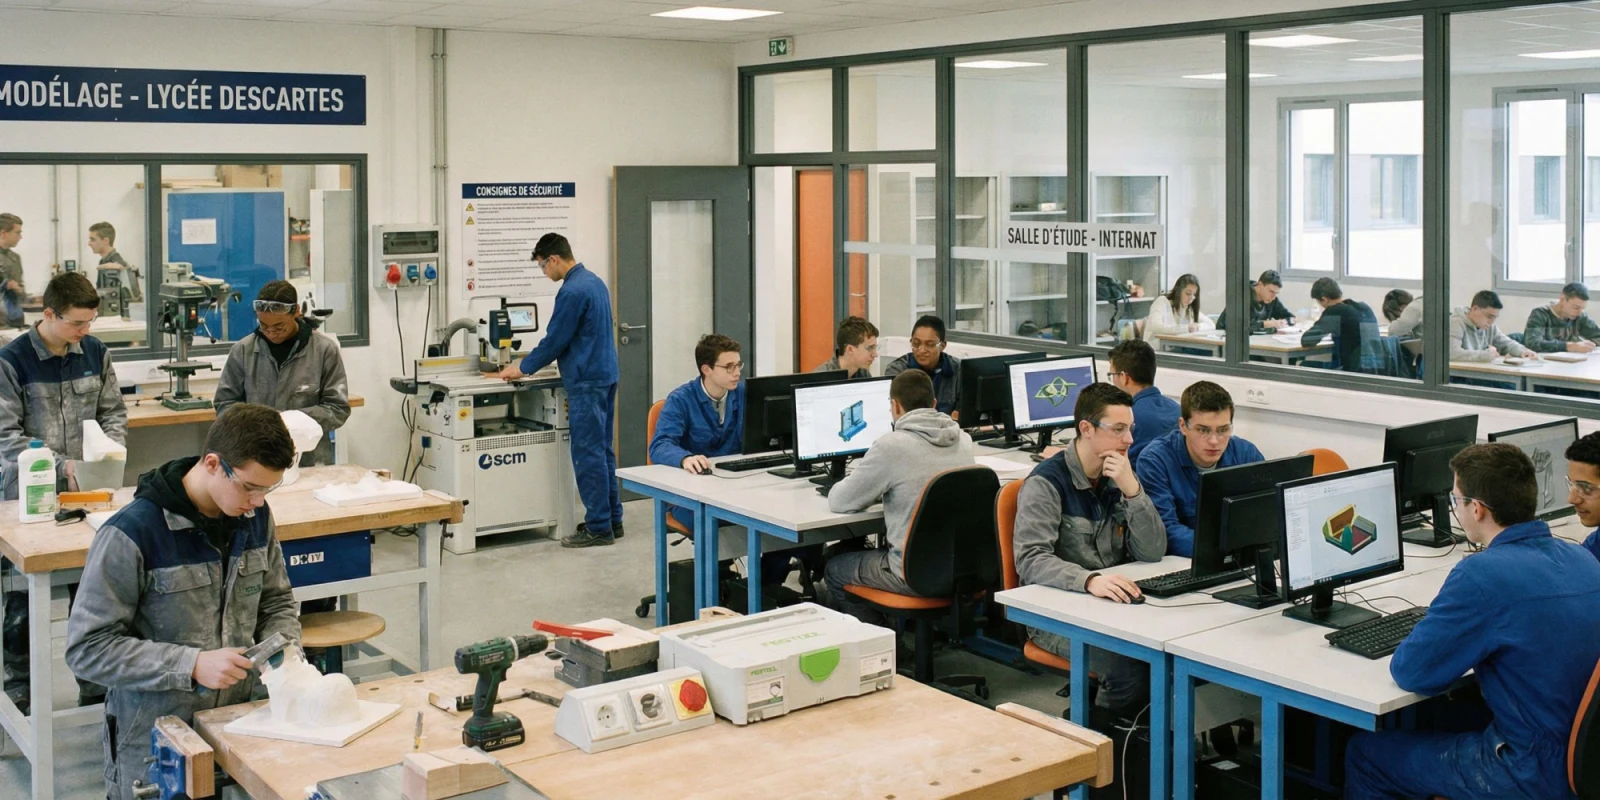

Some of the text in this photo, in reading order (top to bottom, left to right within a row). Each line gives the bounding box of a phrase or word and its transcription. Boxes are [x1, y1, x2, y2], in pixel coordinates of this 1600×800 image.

[147, 78, 213, 110] LYCÉE
[219, 86, 344, 113] DESCARTES
[476, 184, 563, 196] CONSIGNES DE SÉCURITÉ
[1008, 227, 1040, 245] SALLE
[1043, 225, 1088, 246] D'ÉTUDE
[1099, 230, 1157, 249] INTERNAT
[493, 452, 527, 466] scm
